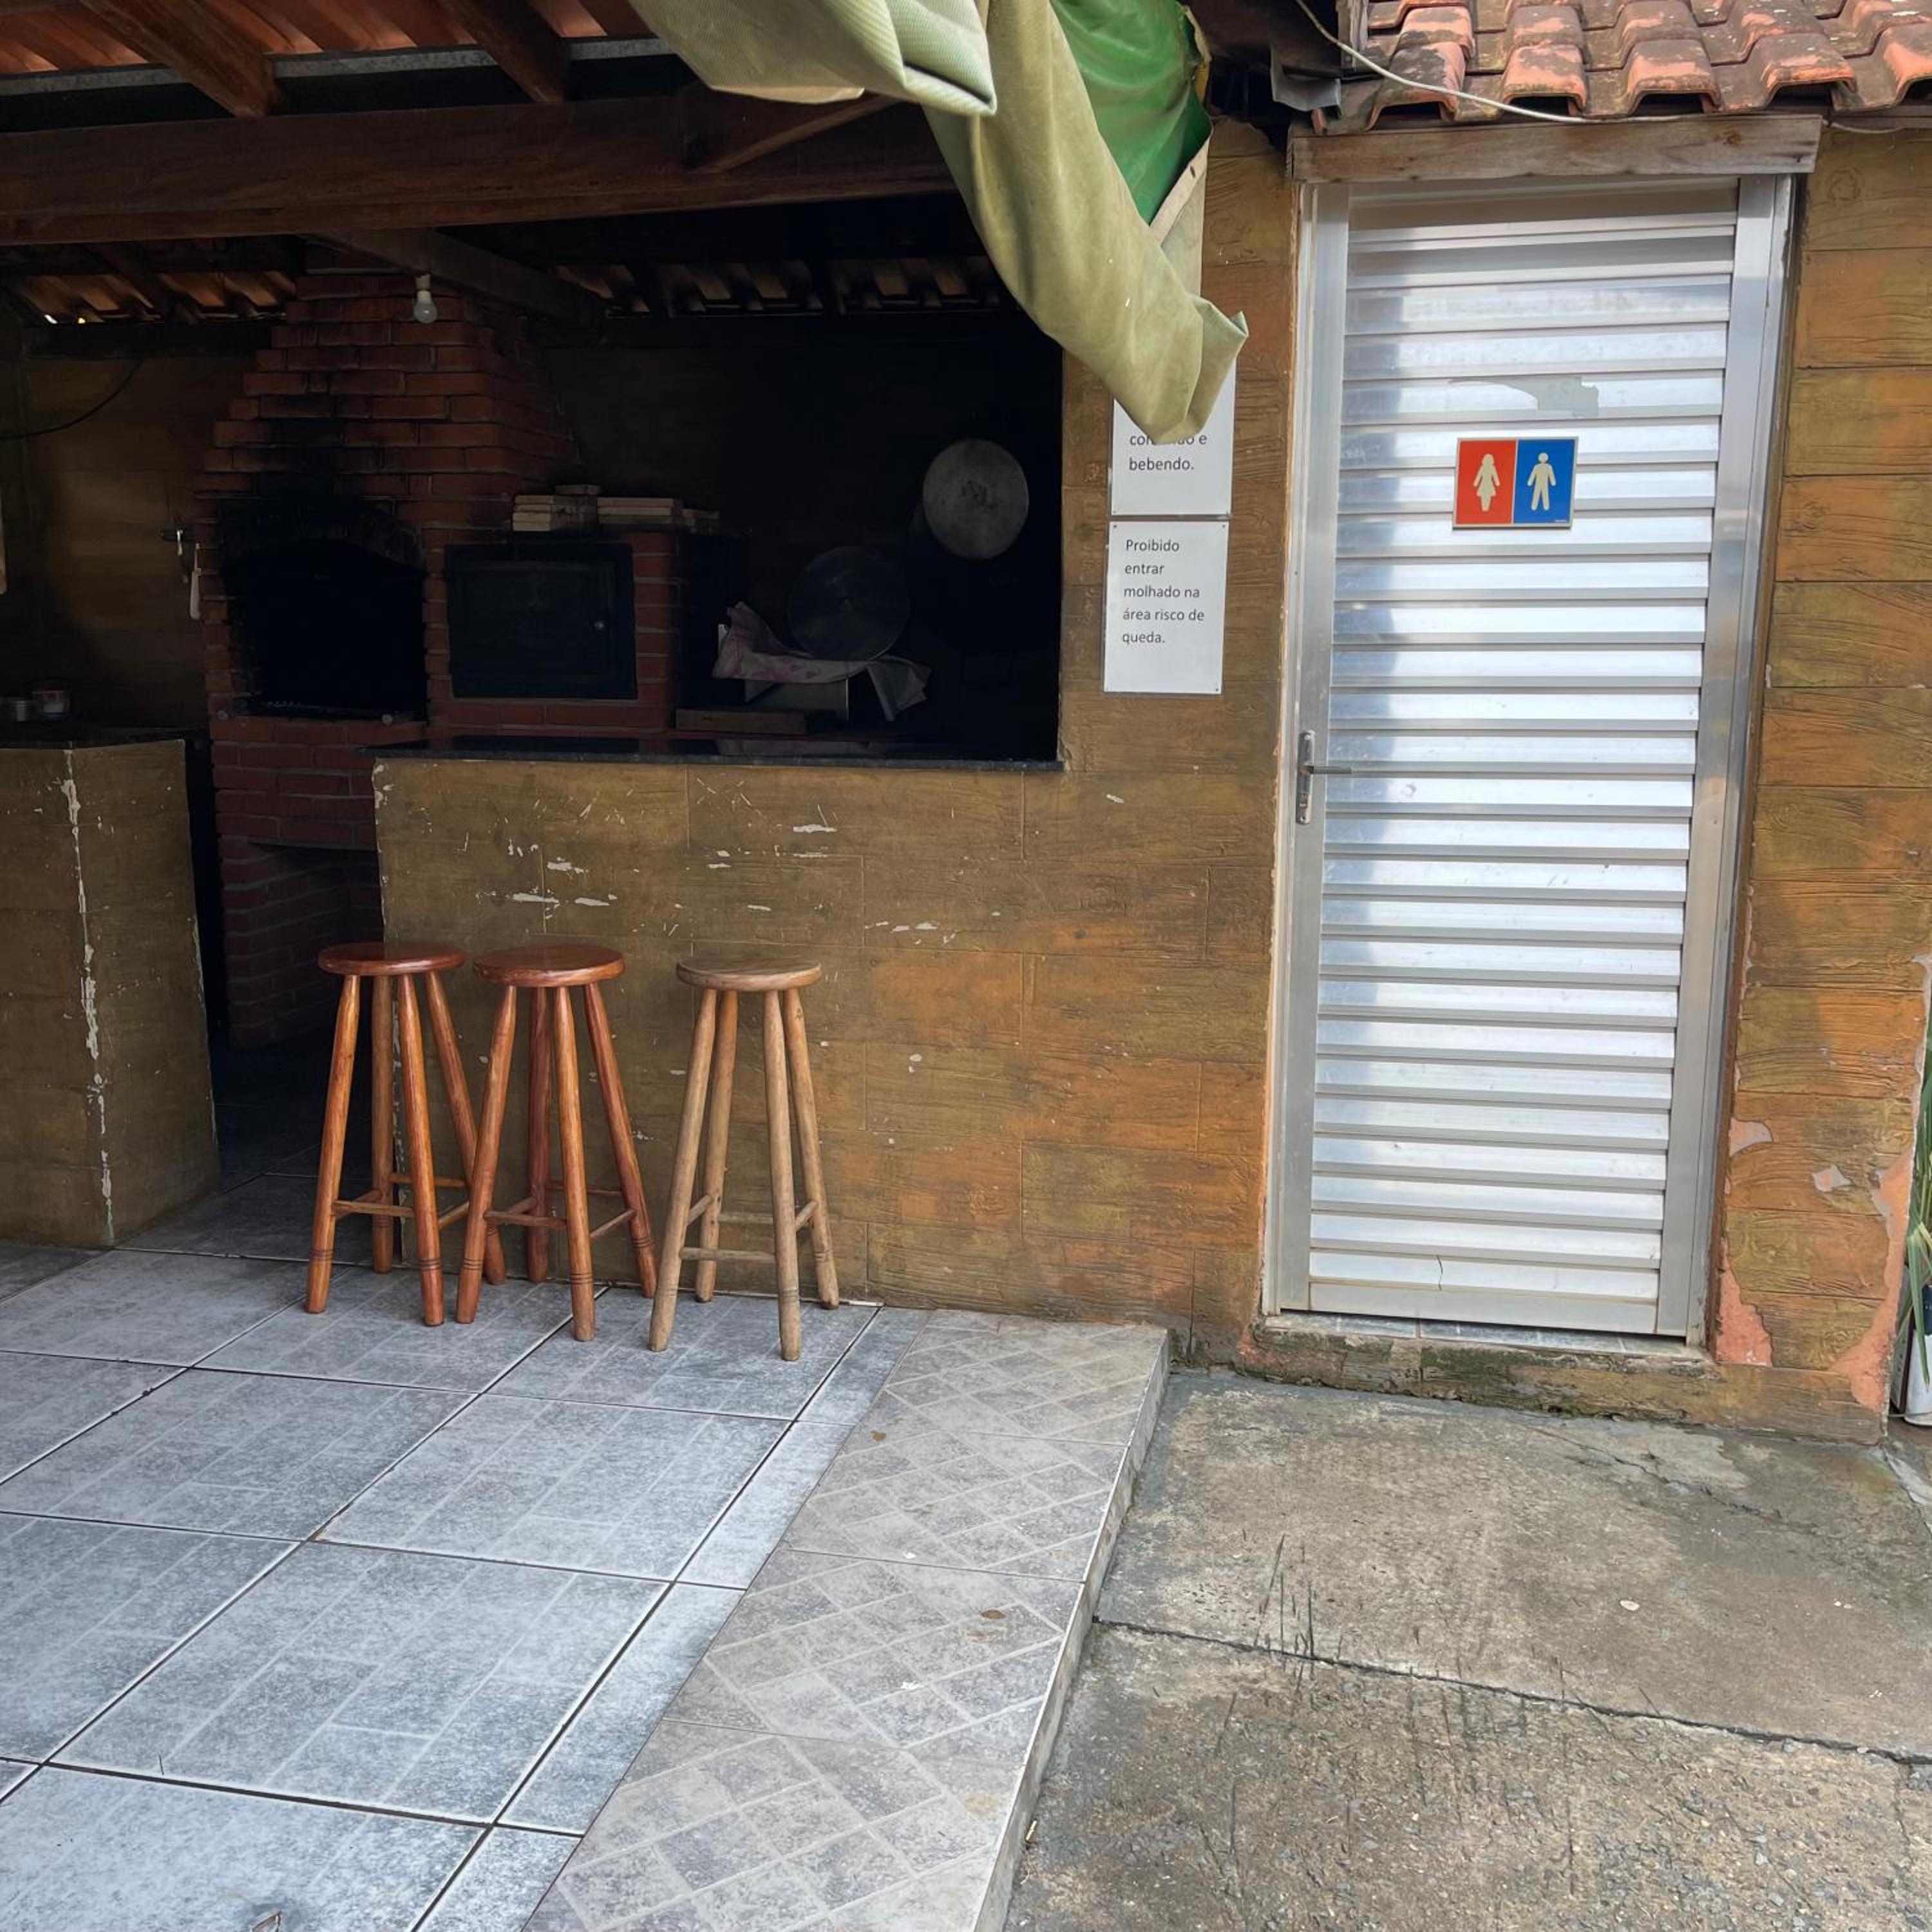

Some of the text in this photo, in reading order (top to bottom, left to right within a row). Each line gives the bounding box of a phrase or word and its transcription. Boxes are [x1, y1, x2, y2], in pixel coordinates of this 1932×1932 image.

[1198, 435, 1208, 445] e
[1129, 457, 1195, 471] bebendo.
[1125, 538, 1180, 552] Proibido
[1124, 564, 1165, 574] entrar
[1124, 585, 1200, 598] molhado na
[1122, 607, 1205, 621] área risco de
[1122, 630, 1166, 645] queda.
